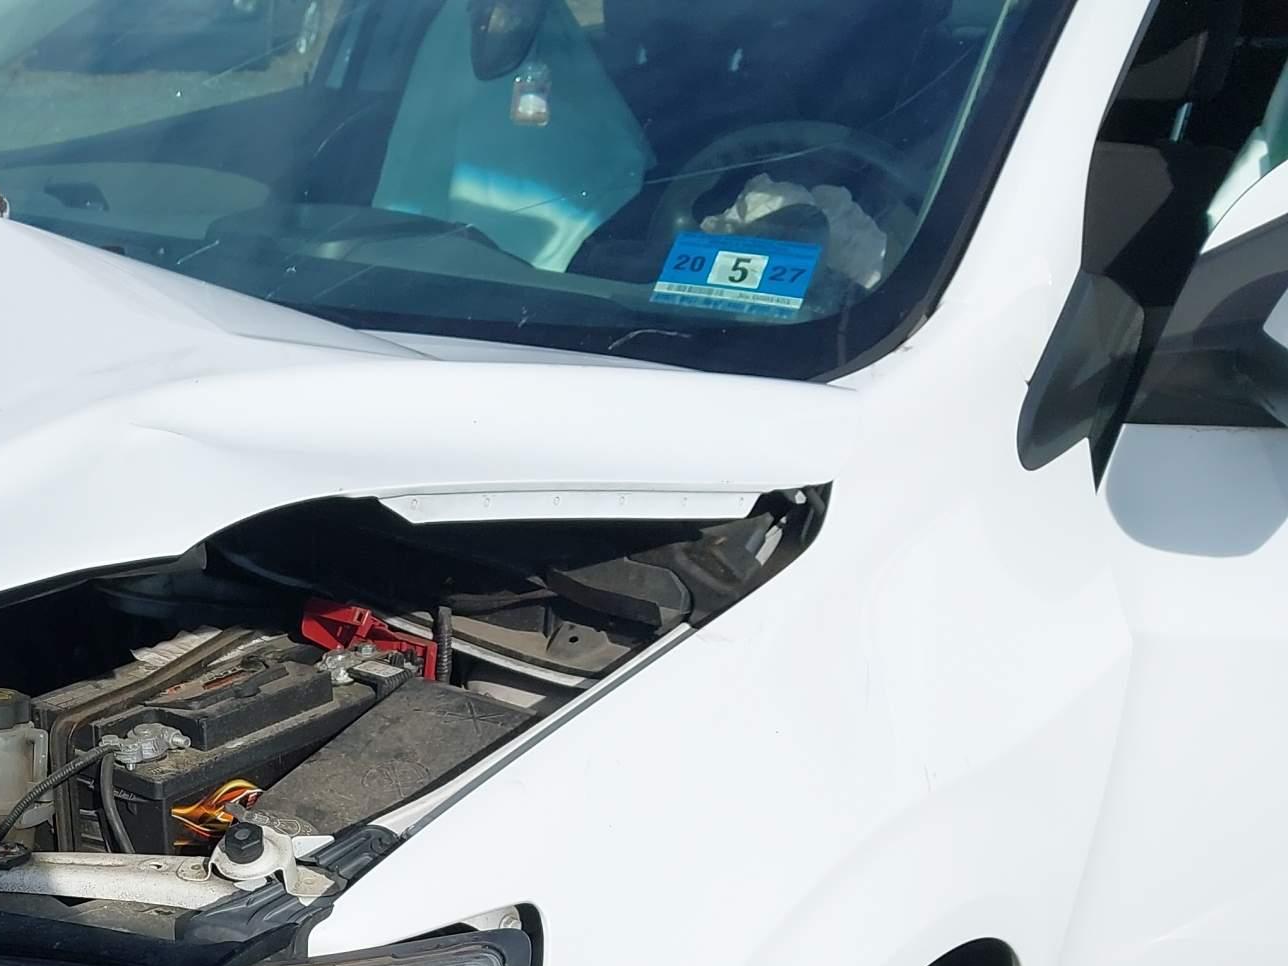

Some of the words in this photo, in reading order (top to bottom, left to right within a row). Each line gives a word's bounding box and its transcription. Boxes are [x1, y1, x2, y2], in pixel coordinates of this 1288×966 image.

[673, 255, 706, 273] 20
[728, 257, 753, 284] 5
[769, 267, 807, 283] 27
